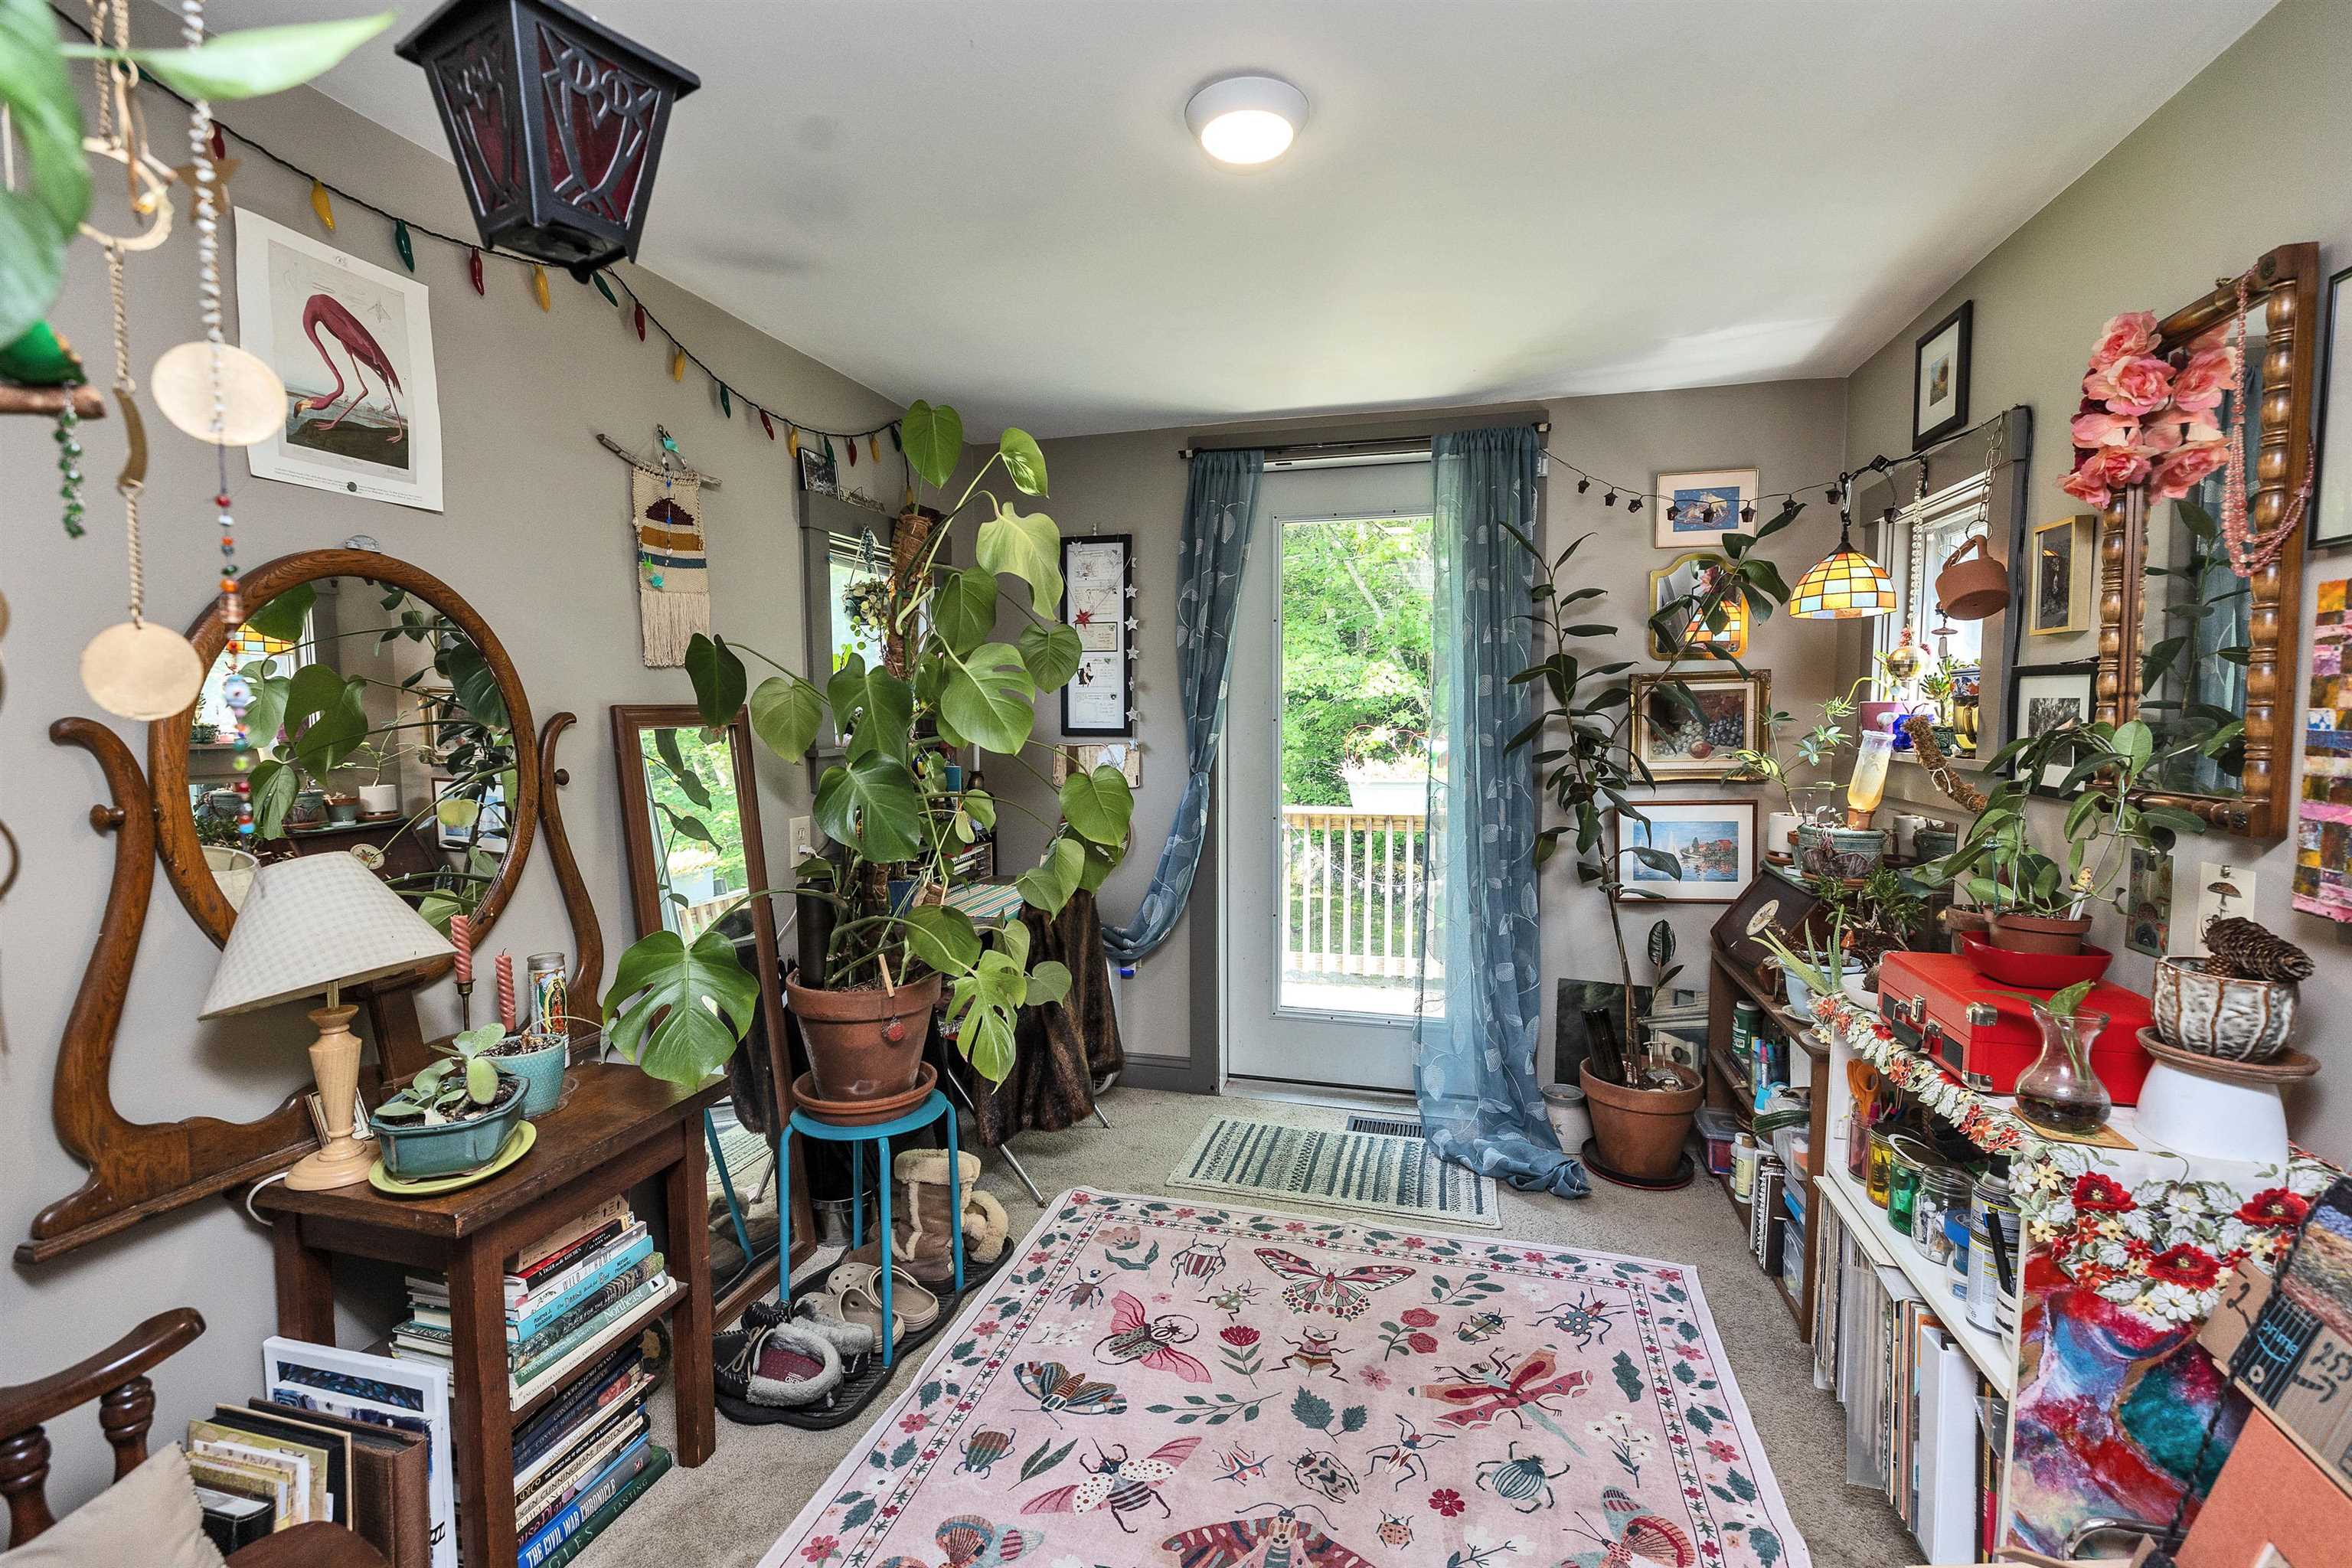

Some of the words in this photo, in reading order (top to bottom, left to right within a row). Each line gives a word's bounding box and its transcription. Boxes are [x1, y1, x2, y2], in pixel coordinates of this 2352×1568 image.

[563, 1272, 580, 1290] WILD
[594, 1252, 612, 1269] HOME
[603, 1289, 643, 1321] Northeast
[2260, 1318, 2298, 1357] prime
[613, 1479, 648, 1513] LANTING
[526, 1543, 544, 1568] THE
[543, 1527, 563, 1556] CIVIL
[563, 1511, 580, 1537] WAR
[580, 1478, 616, 1522] CHRONICLE
